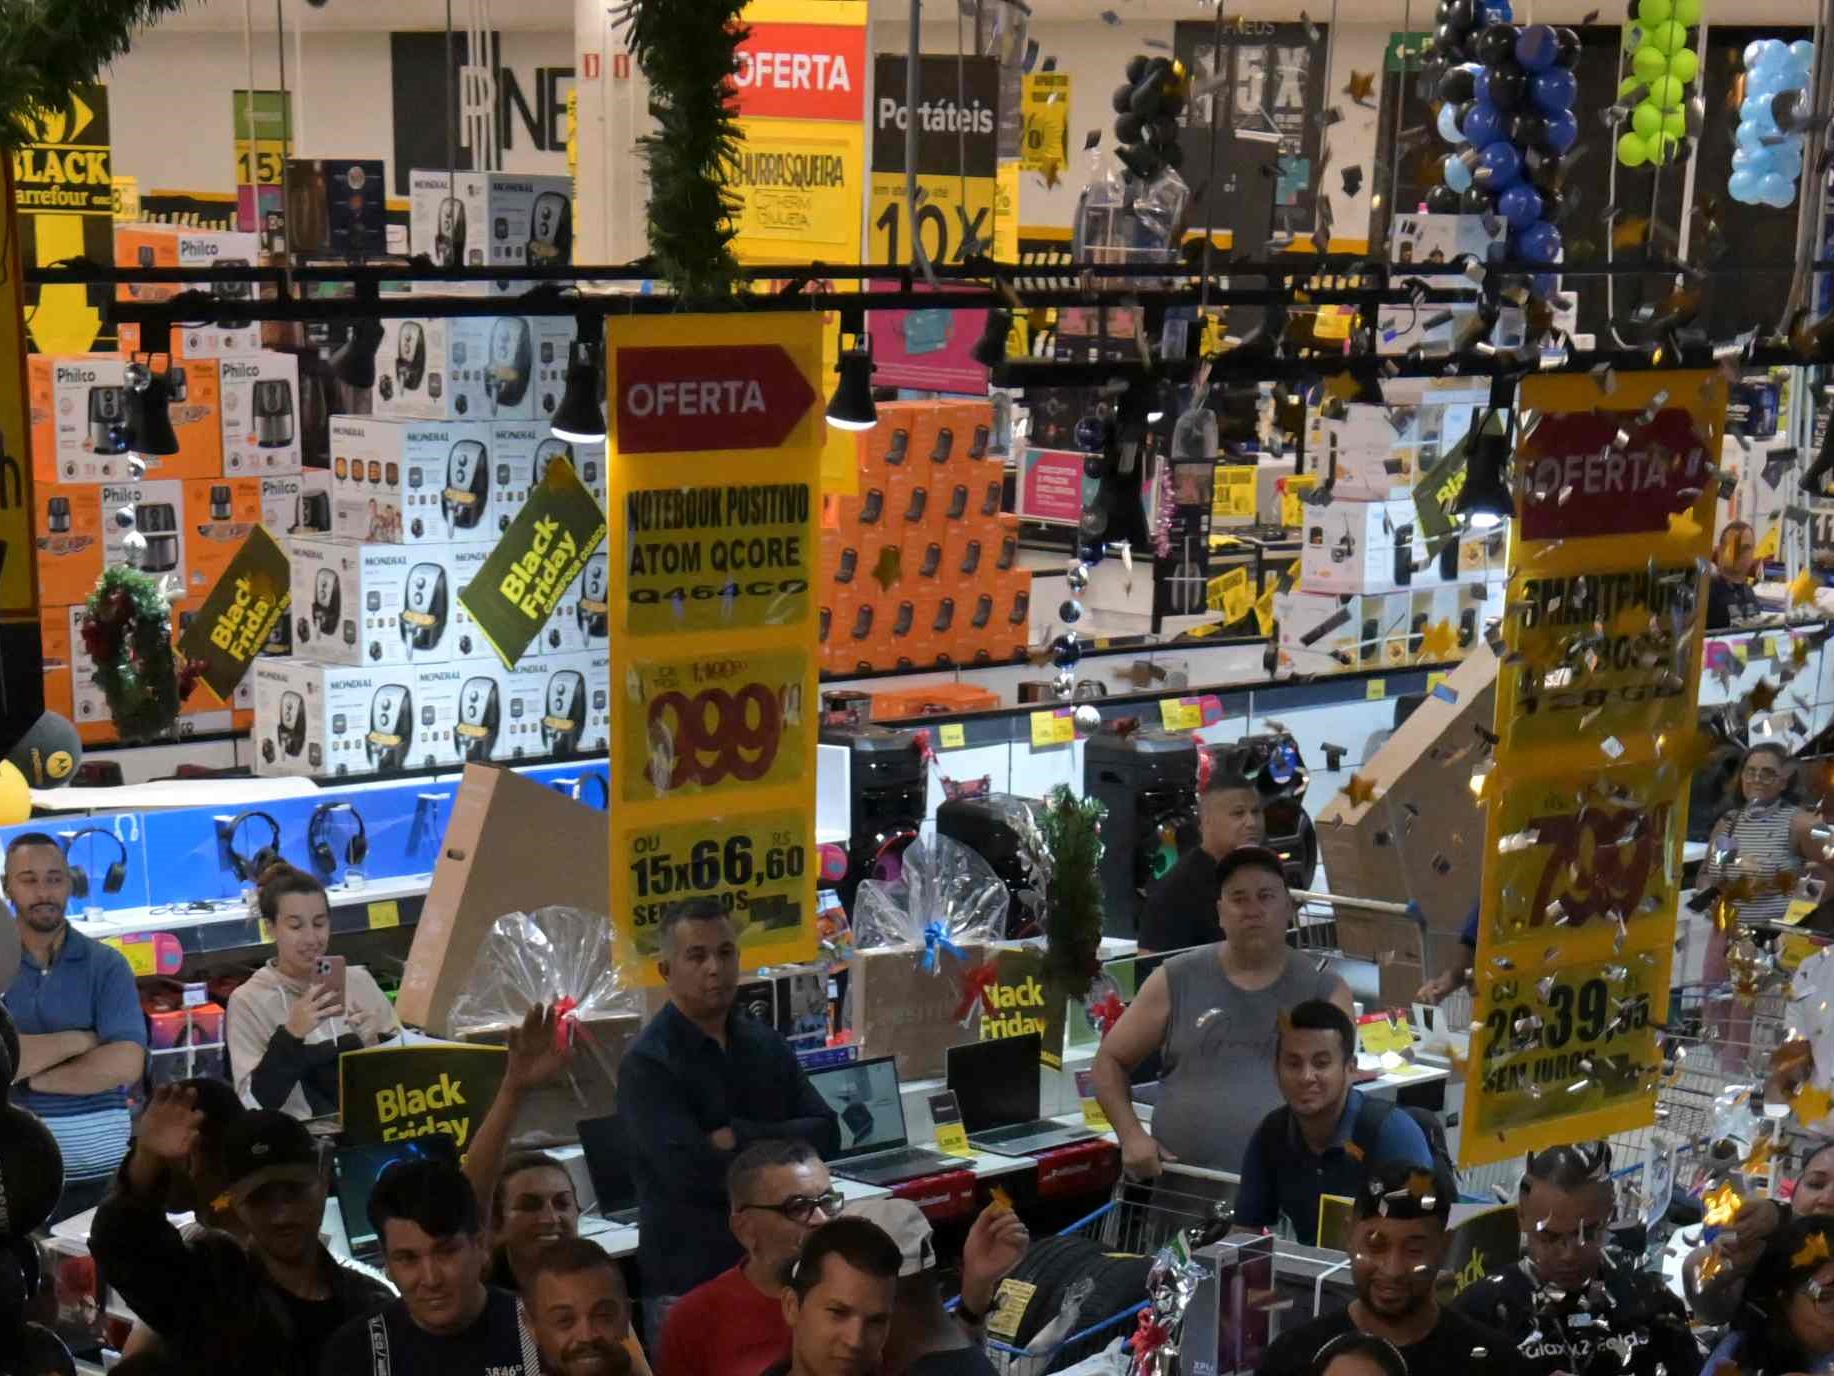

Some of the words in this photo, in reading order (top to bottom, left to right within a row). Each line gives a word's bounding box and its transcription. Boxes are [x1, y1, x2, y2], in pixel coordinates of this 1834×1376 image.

[1222, 21, 1277, 37] PNEUS
[733, 51, 851, 91] OFERTA
[181, 240, 219, 257] Philco
[876, 202, 991, 266] 10X
[57, 367, 96, 384] Philco
[222, 363, 261, 378] Philco
[626, 380, 767, 418] OFERTA
[262, 480, 299, 497] Philco
[1533, 446, 1669, 494] OFERTA
[627, 486, 723, 531] NOTEBOOK
[726, 483, 810, 528] POSITIVO
[498, 514, 560, 606] Black
[518, 529, 578, 621] Friday
[629, 540, 702, 576] ATOM
[709, 536, 801, 573] QCORE
[210, 572, 253, 651] Black
[633, 834, 661, 853] OU
[629, 836, 806, 899] 15x66,60
[375, 1072, 468, 1124] Black
